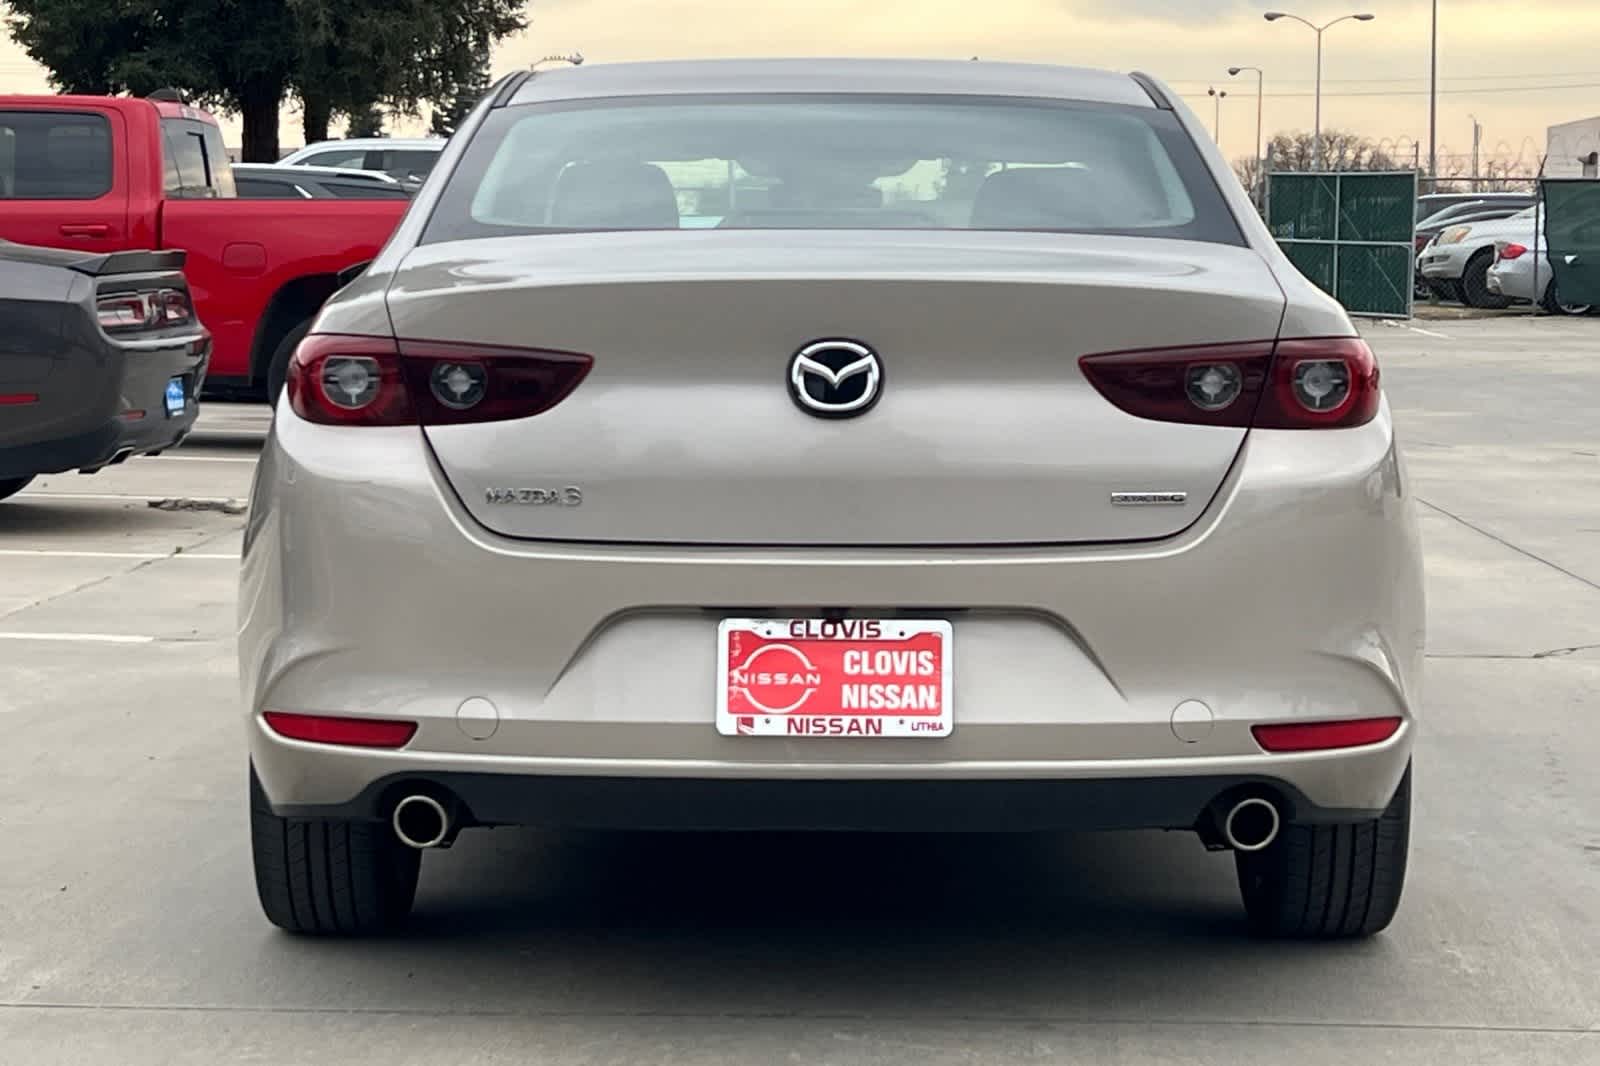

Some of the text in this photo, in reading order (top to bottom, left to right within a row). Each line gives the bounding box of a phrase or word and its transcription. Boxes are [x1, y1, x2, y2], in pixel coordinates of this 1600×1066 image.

[790, 620, 881, 638] CLOVIS
[843, 650, 935, 676] CLOVIS
[735, 672, 821, 686] NISSAN
[841, 684, 936, 710] NISSAN
[787, 717, 882, 735] NISSAN
